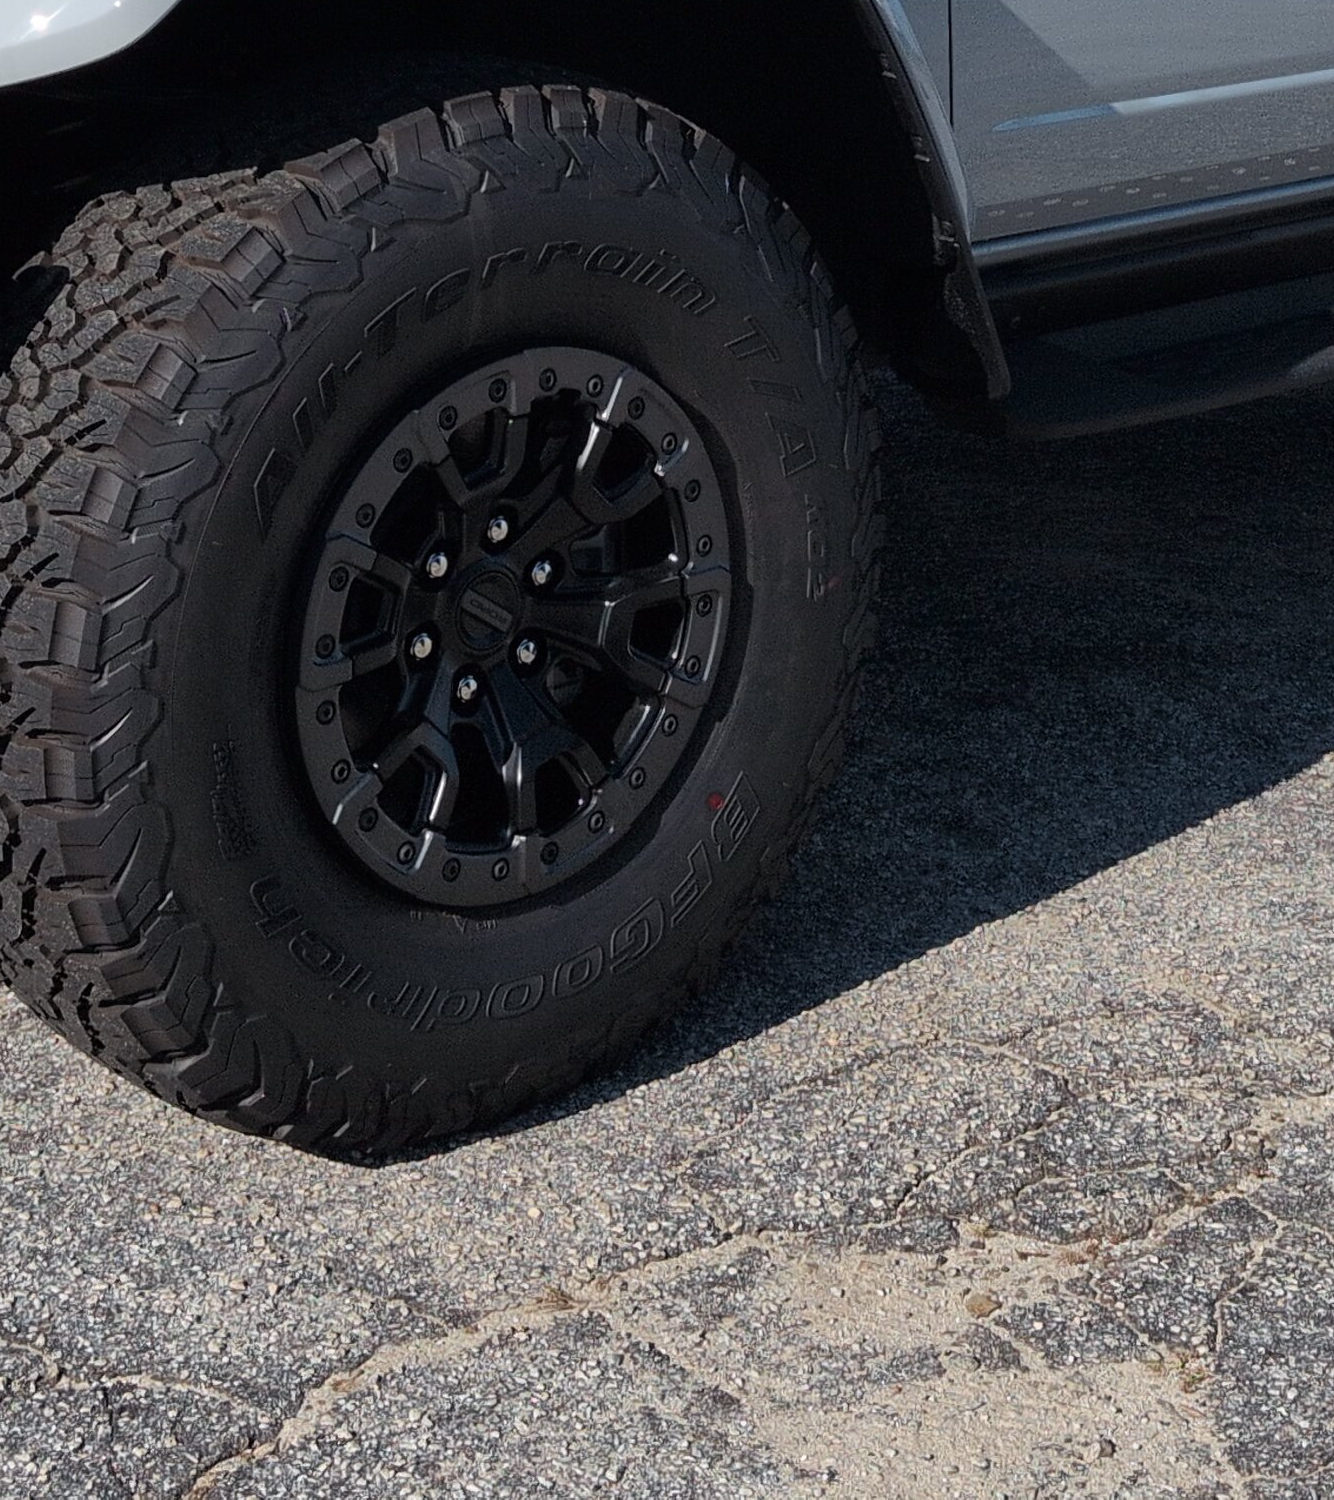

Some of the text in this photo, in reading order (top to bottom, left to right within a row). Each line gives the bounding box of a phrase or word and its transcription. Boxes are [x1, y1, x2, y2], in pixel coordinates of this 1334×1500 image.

[251, 238, 719, 545] All-Terrain
[723, 314, 817, 478] T/A
[248, 768, 762, 1032] BFGoodrich
